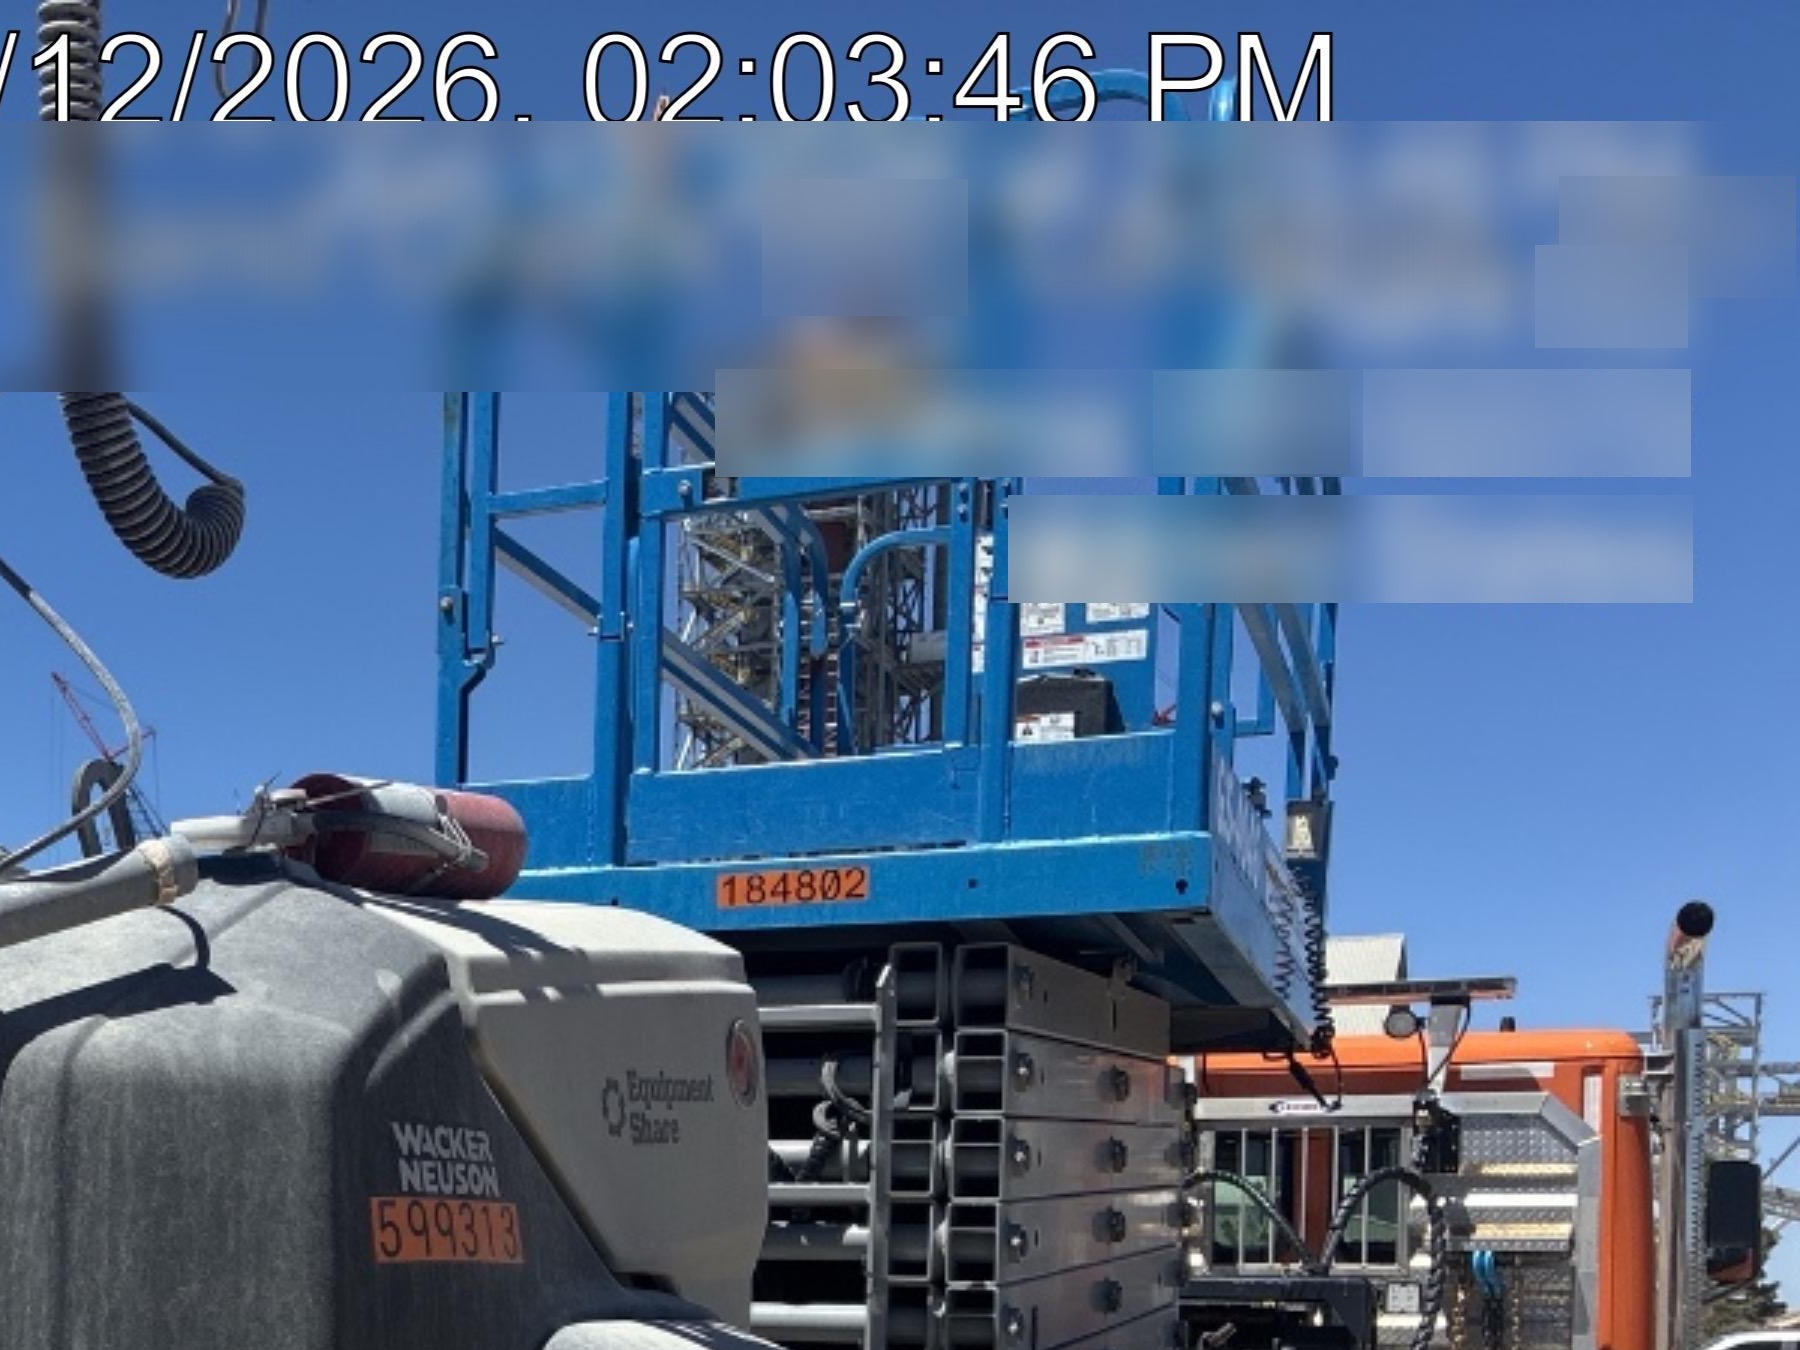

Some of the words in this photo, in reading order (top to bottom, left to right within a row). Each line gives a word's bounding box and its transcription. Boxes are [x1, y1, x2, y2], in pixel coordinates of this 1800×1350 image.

[722, 866, 866, 907] 184802
[627, 1069, 714, 1110] Equipment
[391, 1122, 494, 1162] WACKER
[630, 1111, 680, 1145] Share
[399, 1158, 500, 1197] NEUSON
[378, 1201, 518, 1260] 599313
